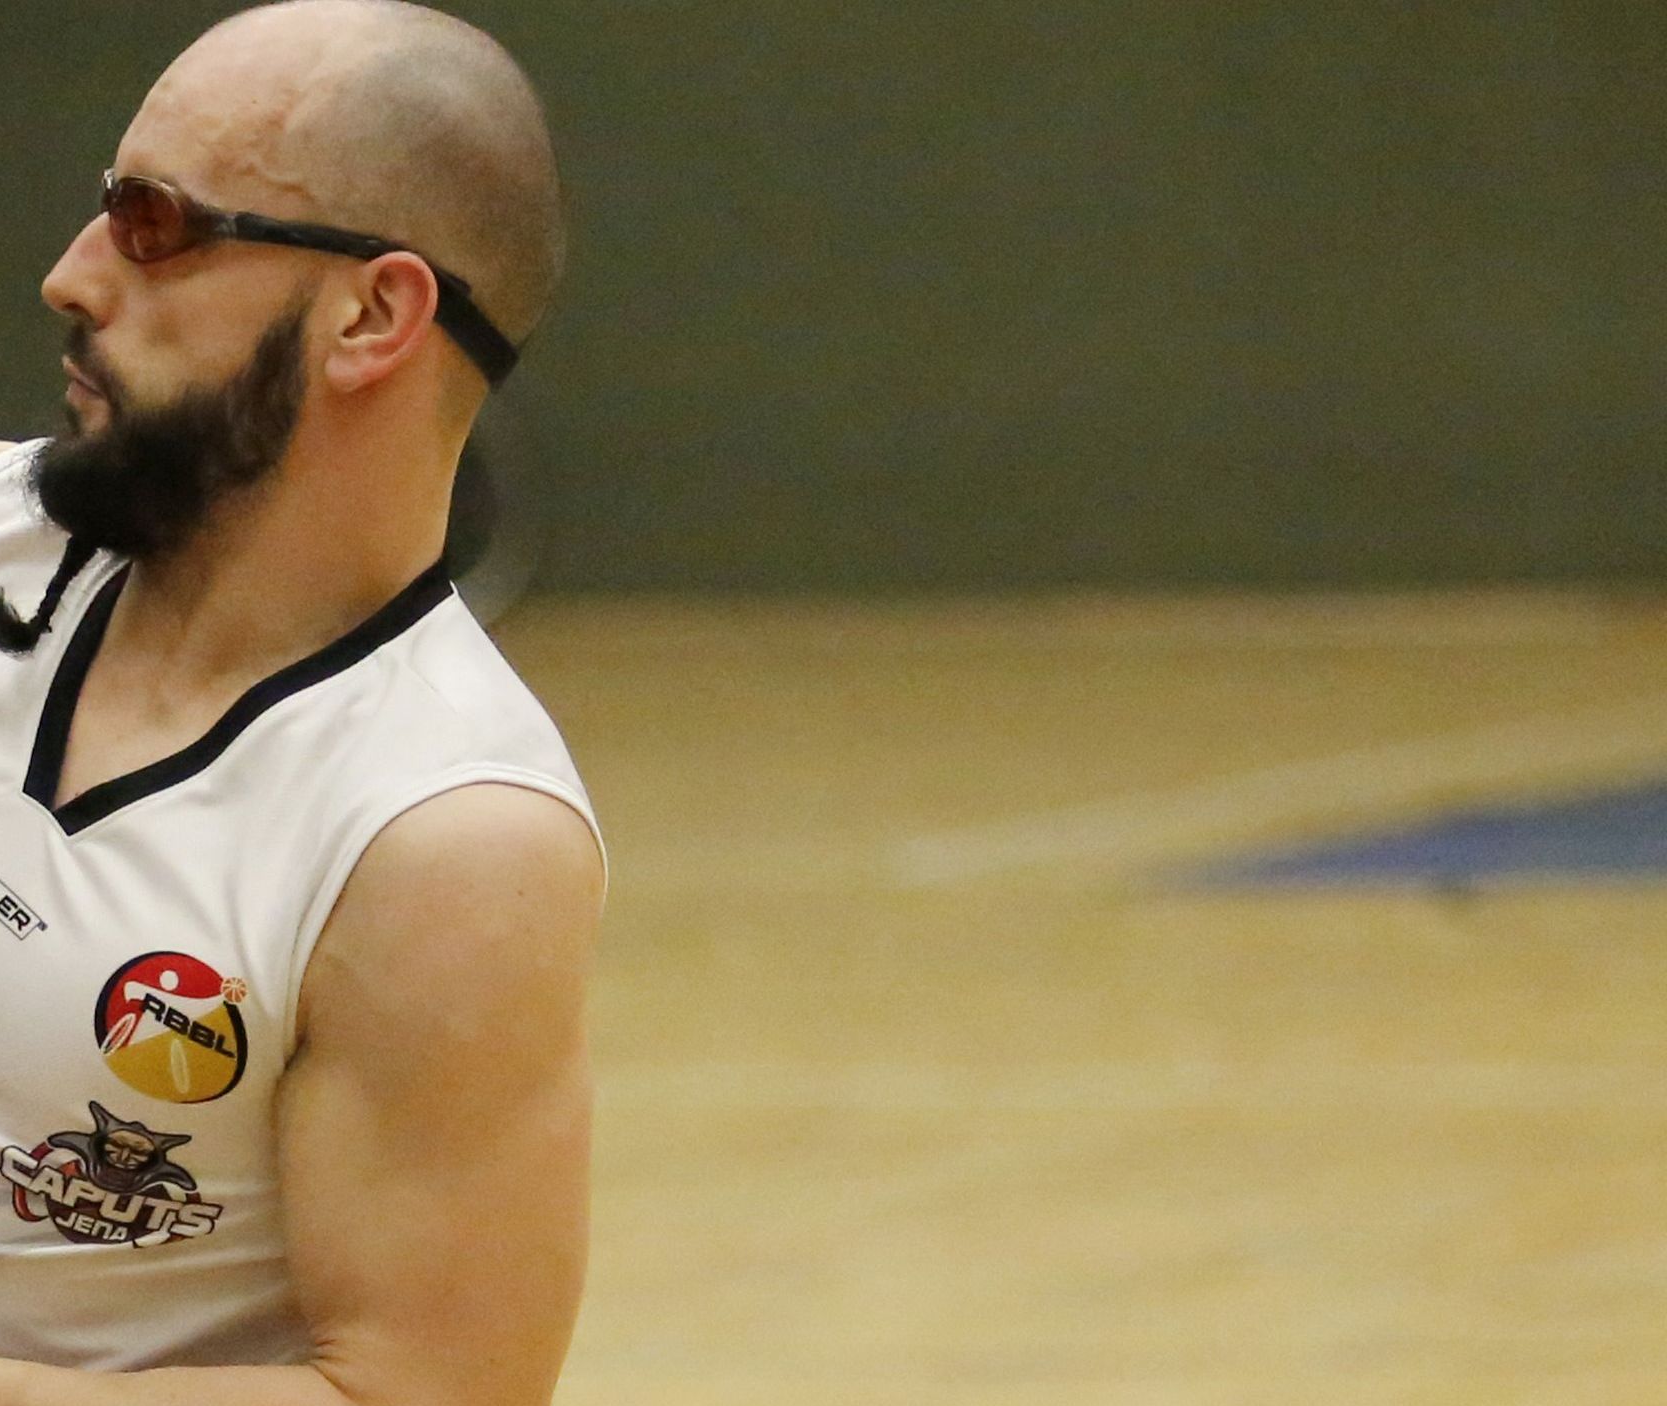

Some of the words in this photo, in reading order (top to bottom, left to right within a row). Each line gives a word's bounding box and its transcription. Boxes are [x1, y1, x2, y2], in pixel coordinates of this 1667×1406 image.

[141, 992, 237, 1059] RBBL
[0, 1146, 223, 1238] CAPUTS
[54, 1211, 129, 1241] JENA
